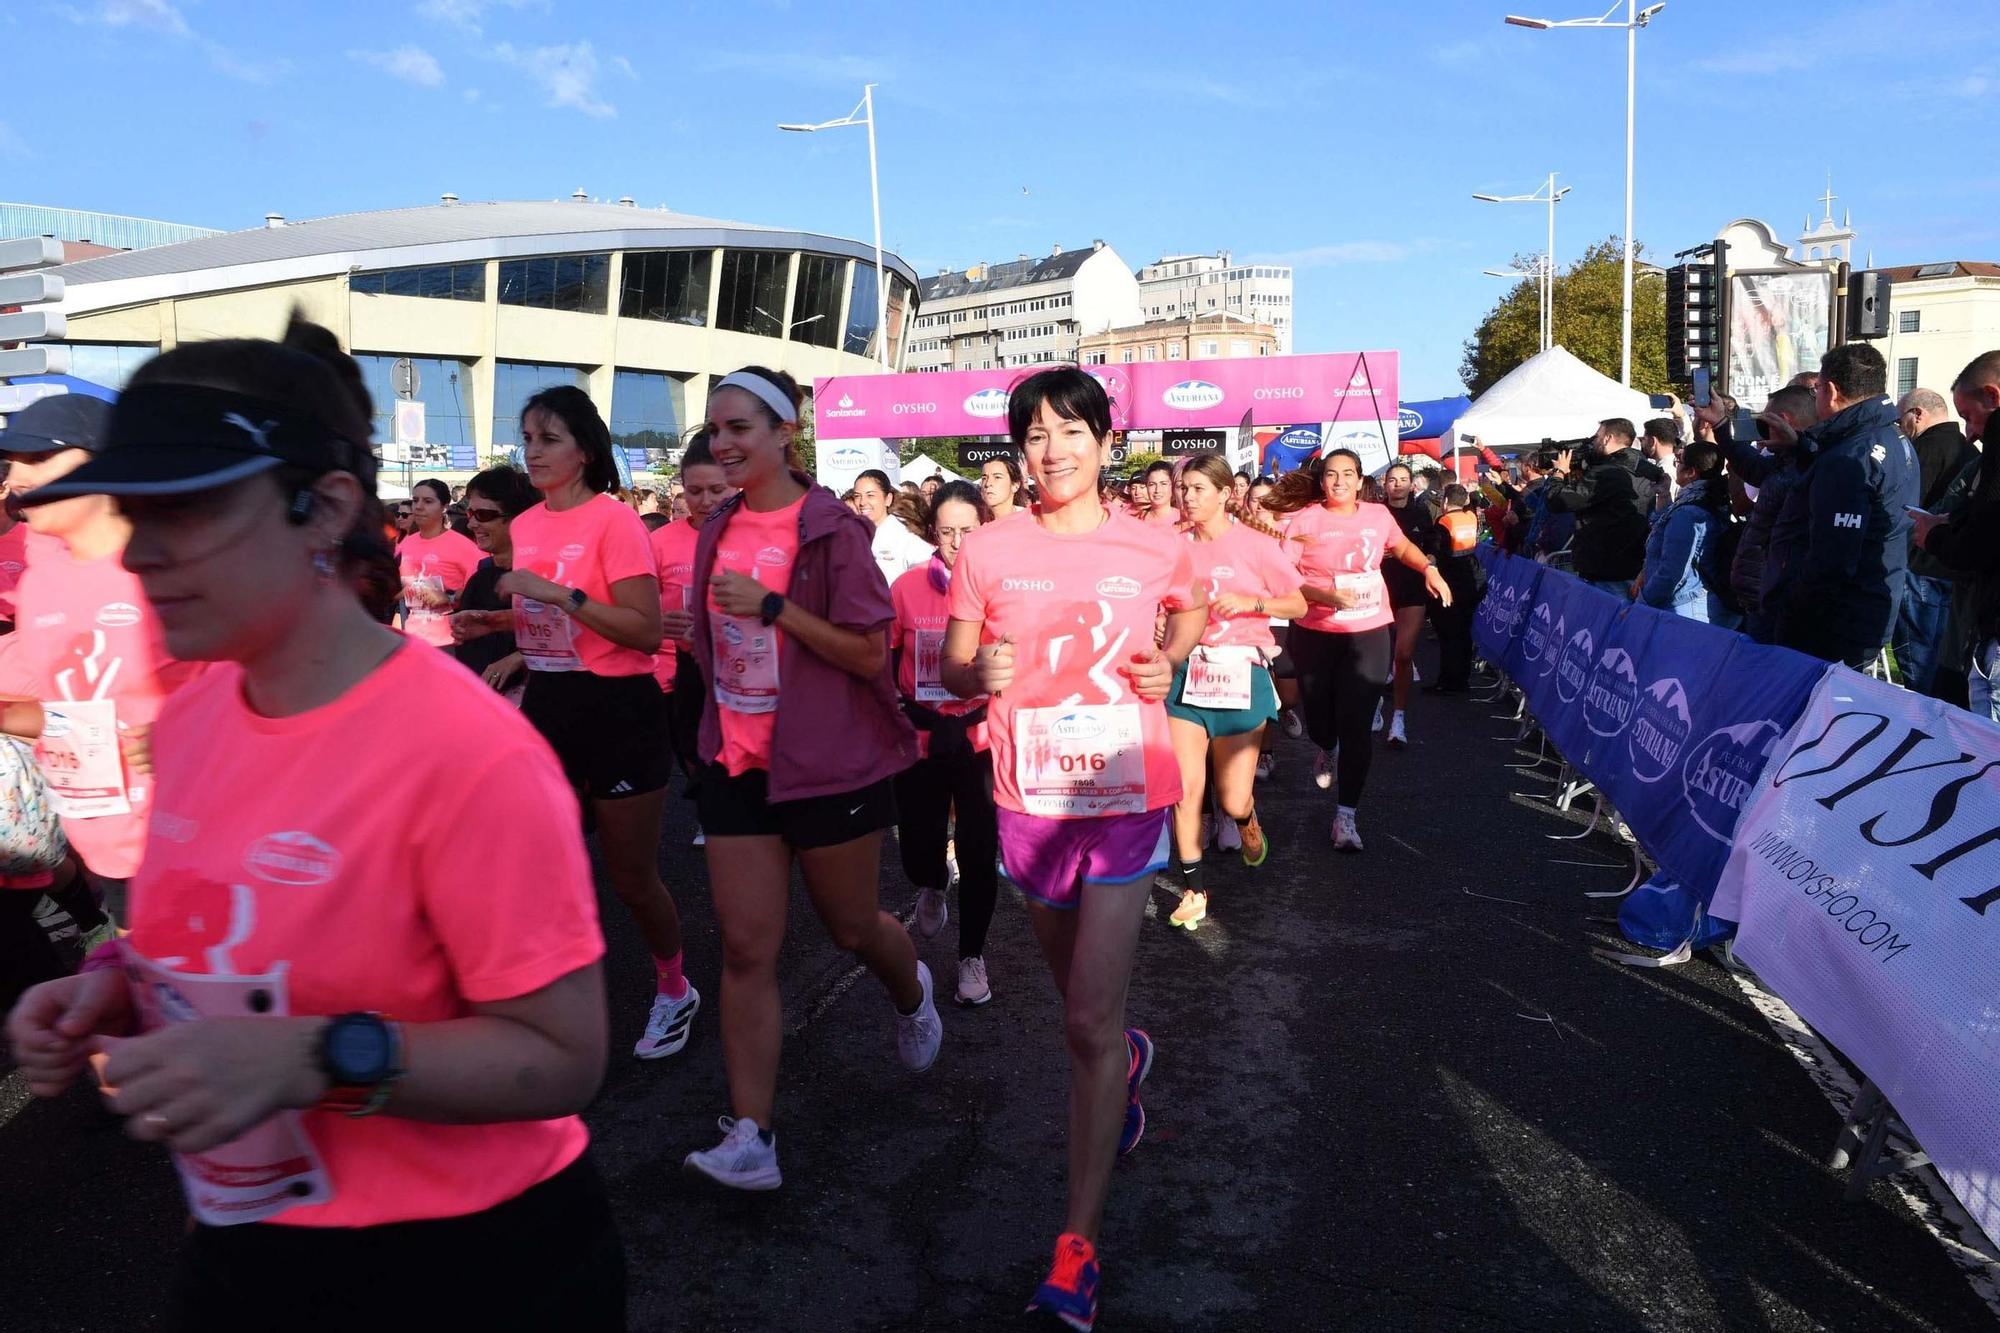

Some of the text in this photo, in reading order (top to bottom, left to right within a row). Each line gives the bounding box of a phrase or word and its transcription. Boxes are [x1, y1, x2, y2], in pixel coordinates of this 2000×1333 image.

[1168, 391, 1219, 403] ASTURIANA
[1254, 387, 1304, 400] OYSHO
[1334, 388, 1383, 397] Santander
[825, 408, 867, 418] Santander
[892, 402, 937, 415] OYSHO
[1171, 439, 1218, 450] OYSHO
[1834, 512, 1862, 528] HH
[1001, 578, 1055, 592] OYSHO
[527, 623, 552, 638] 016
[1207, 674, 1231, 684] 016
[1059, 752, 1106, 773] 016
[1749, 829, 1912, 964] WWW.OYSHO.COM
